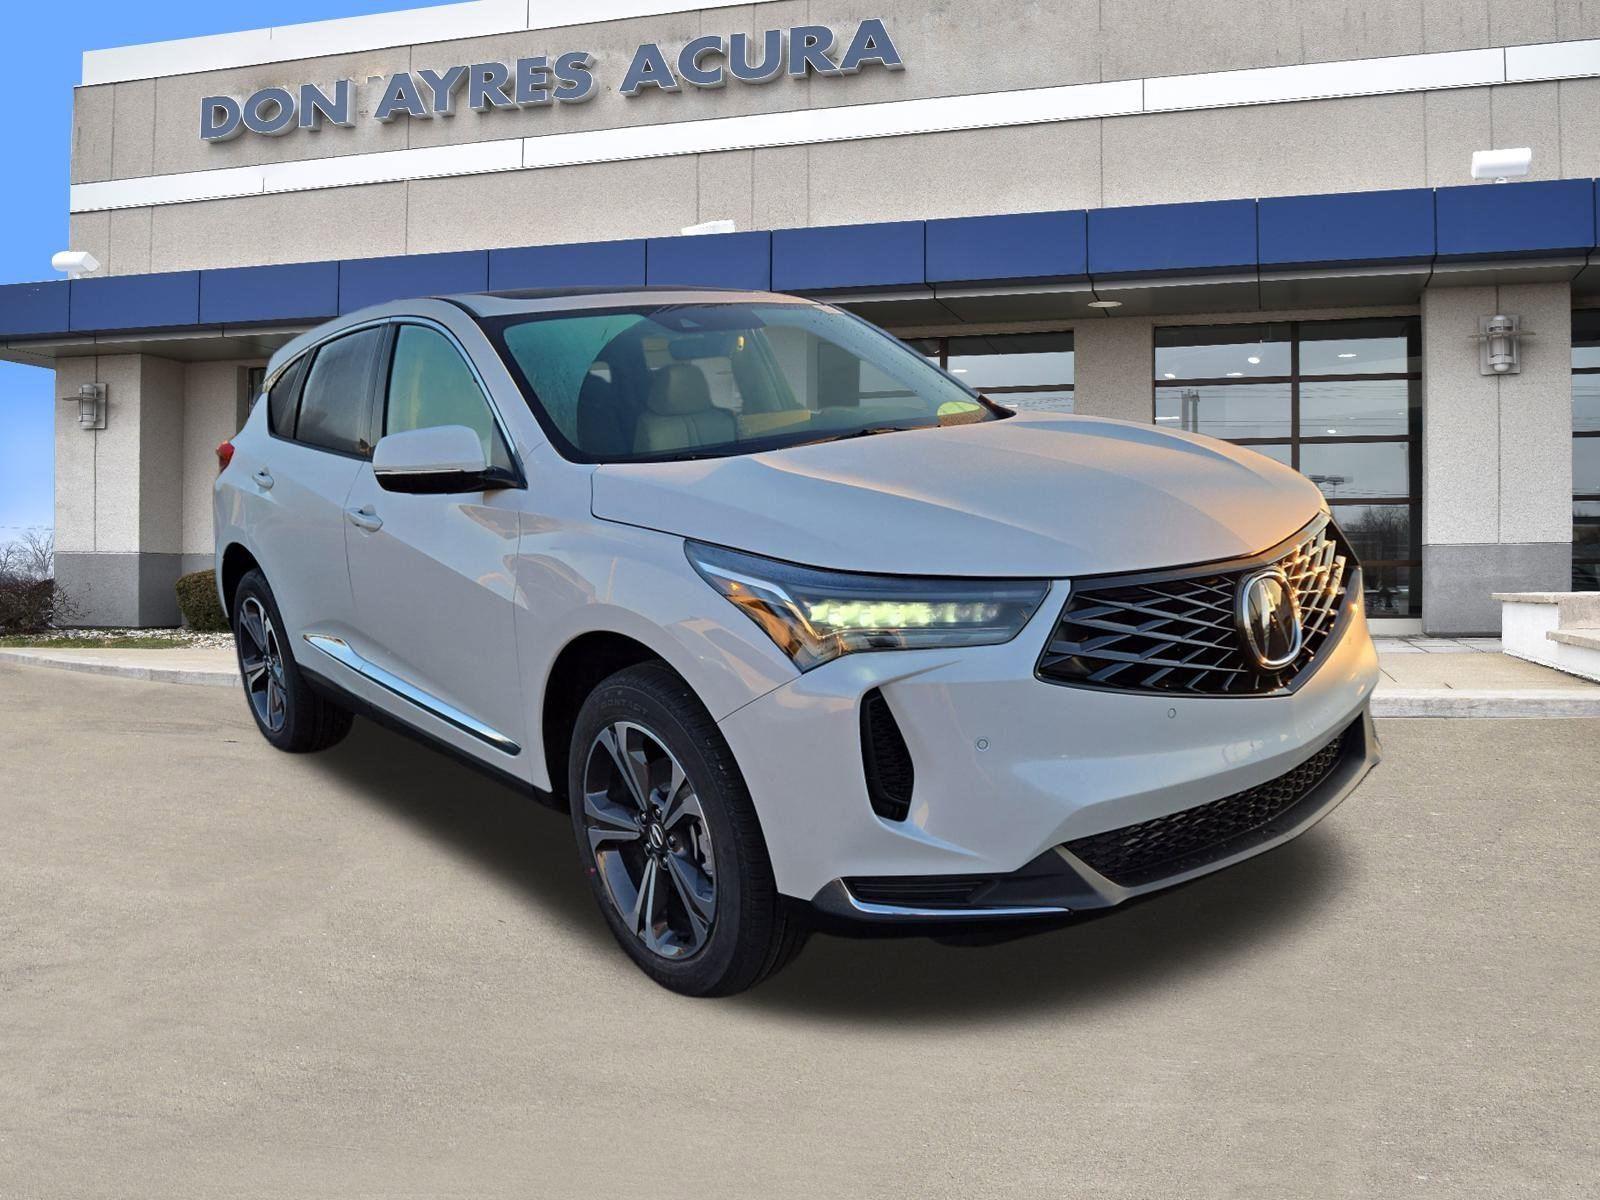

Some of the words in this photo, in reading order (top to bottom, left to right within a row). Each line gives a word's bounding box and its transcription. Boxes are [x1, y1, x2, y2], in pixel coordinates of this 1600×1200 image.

[200, 79, 356, 142] DON
[374, 52, 597, 124] AYRES
[619, 18, 905, 97] ACURA
